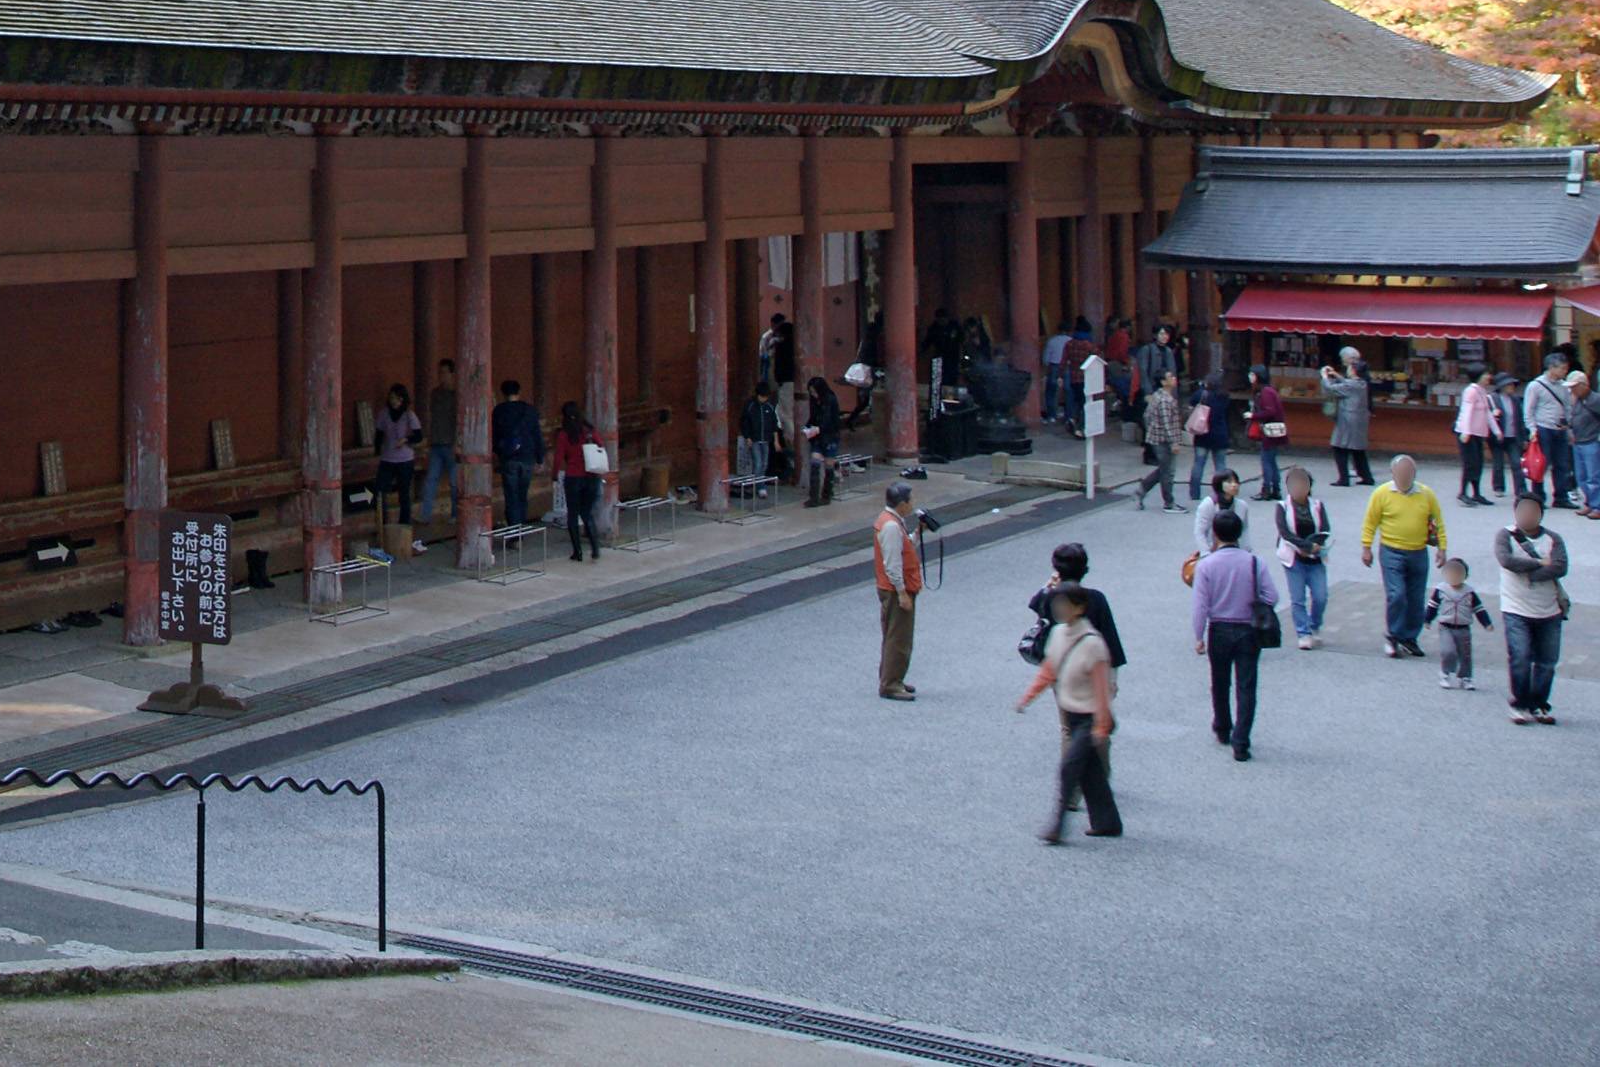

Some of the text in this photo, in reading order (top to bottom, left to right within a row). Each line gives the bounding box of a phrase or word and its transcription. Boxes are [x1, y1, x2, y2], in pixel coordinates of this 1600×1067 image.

[172, 532, 185, 632] お出し下さい。
[185, 521, 198, 582] 受付所に
[199, 534, 213, 625] お参りの前に
[213, 523, 227, 638] 朱印をされる方は
